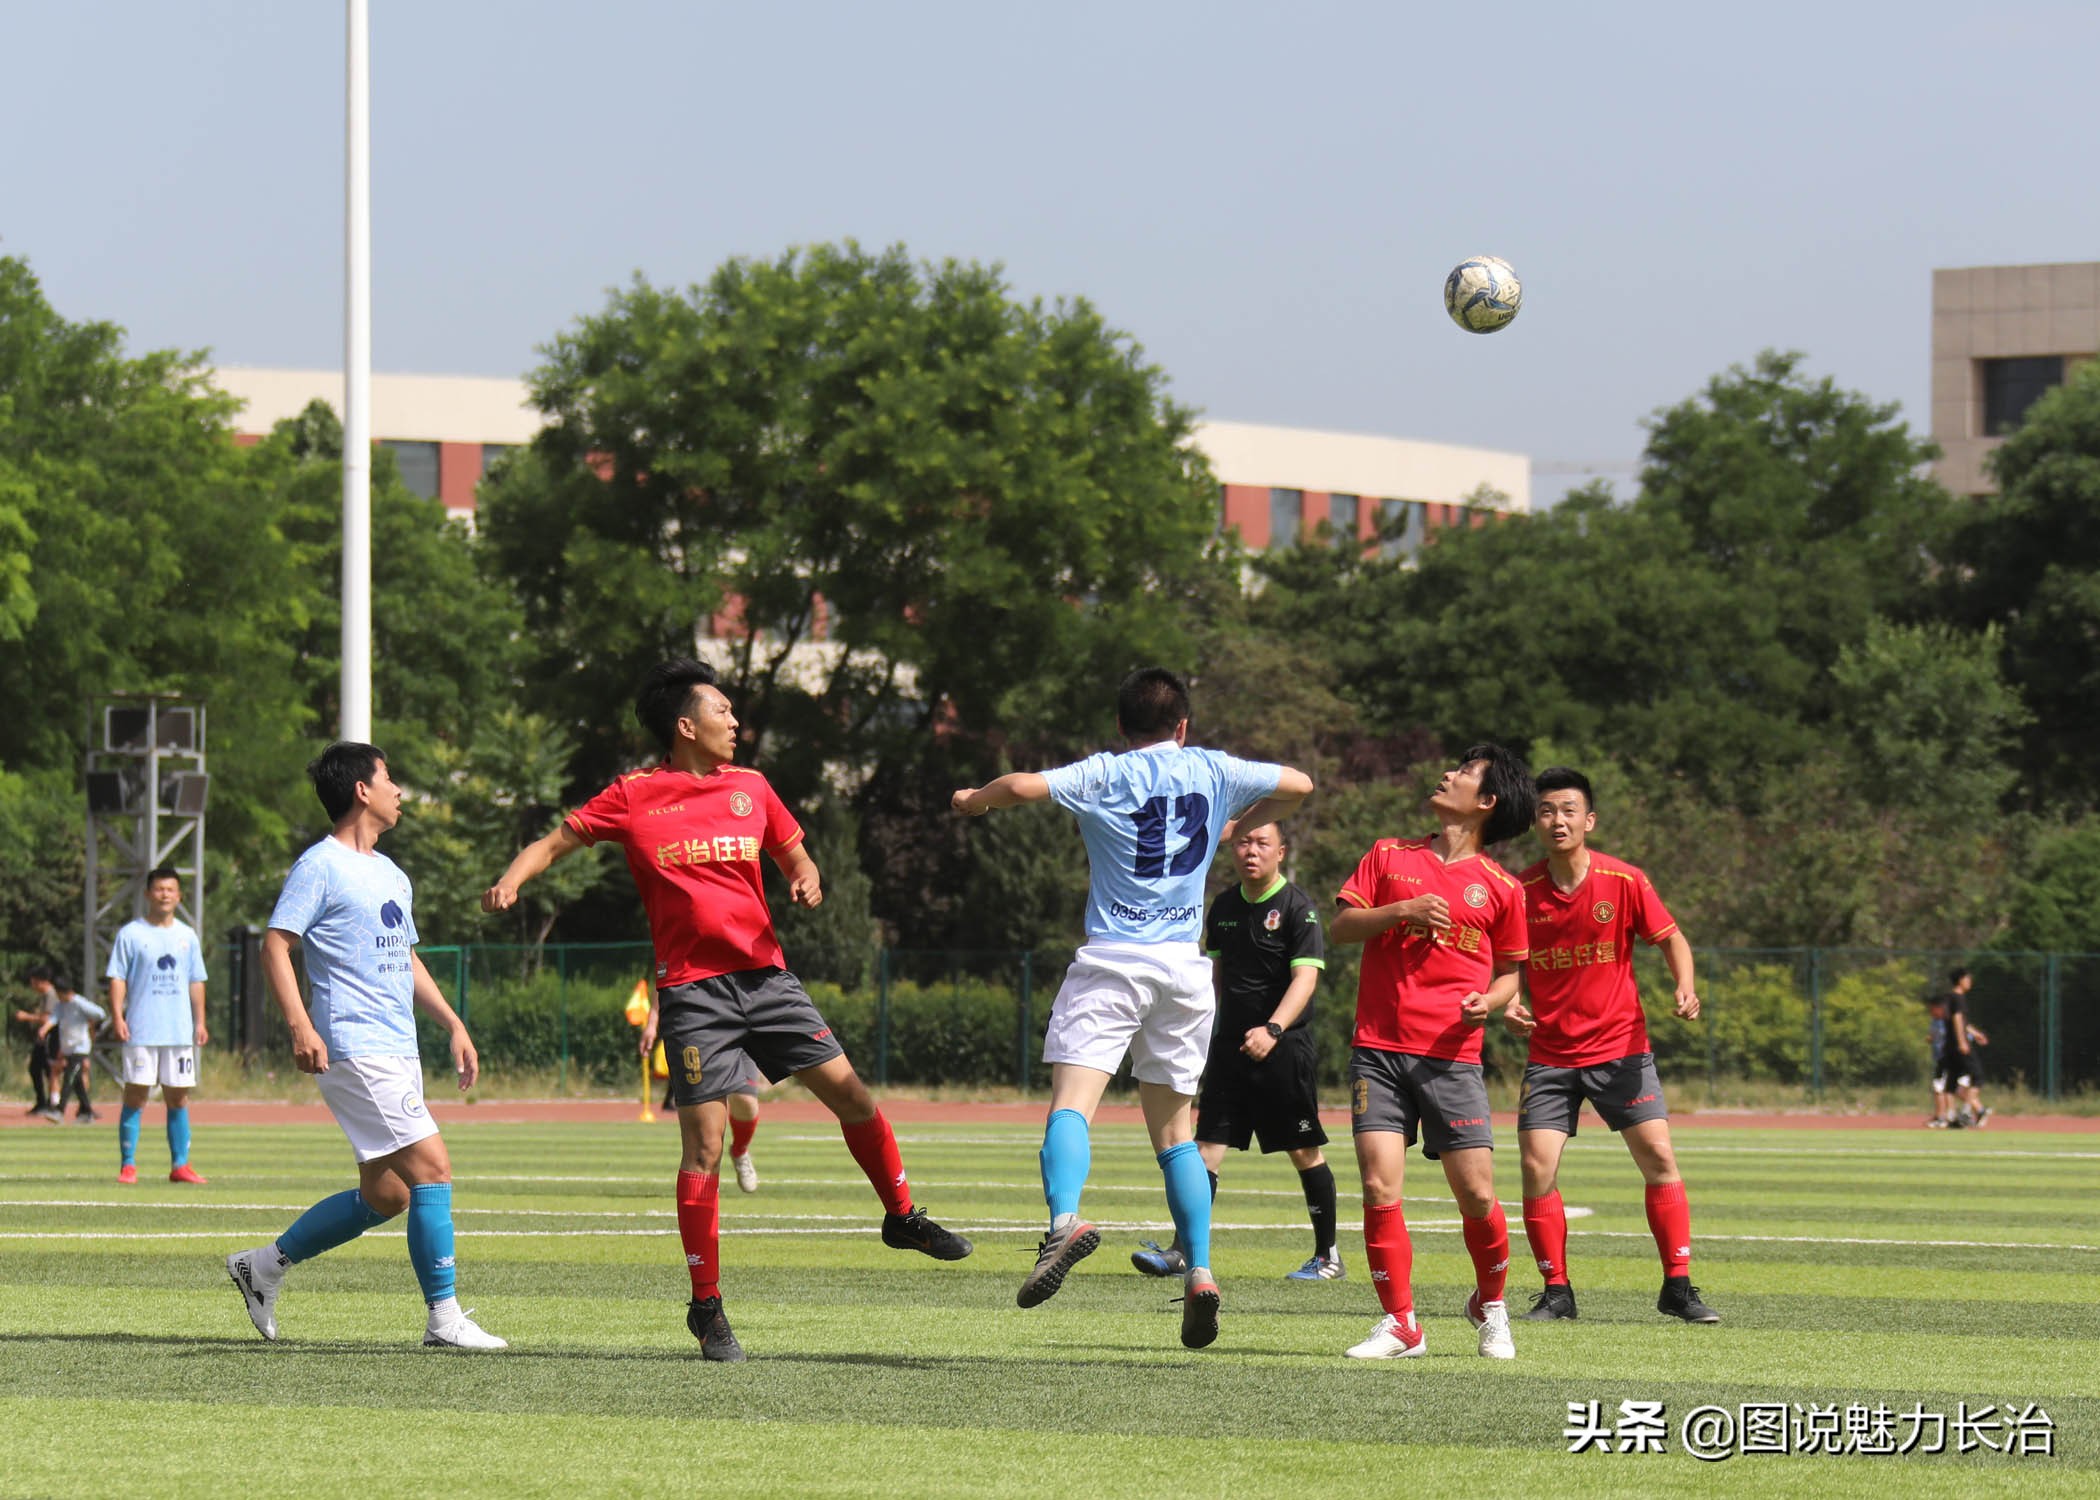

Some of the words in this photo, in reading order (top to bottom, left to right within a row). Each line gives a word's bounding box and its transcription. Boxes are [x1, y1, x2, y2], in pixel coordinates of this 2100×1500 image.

[648, 804, 685, 816] KELME
[1129, 792, 1209, 878] 13
[1386, 873, 1423, 886] KELME
[1110, 901, 1202, 921] 0355-729281
[178, 1057, 193, 1074] 10
[682, 1046, 702, 1085] 9
[1450, 1118, 1485, 1128] KELME
